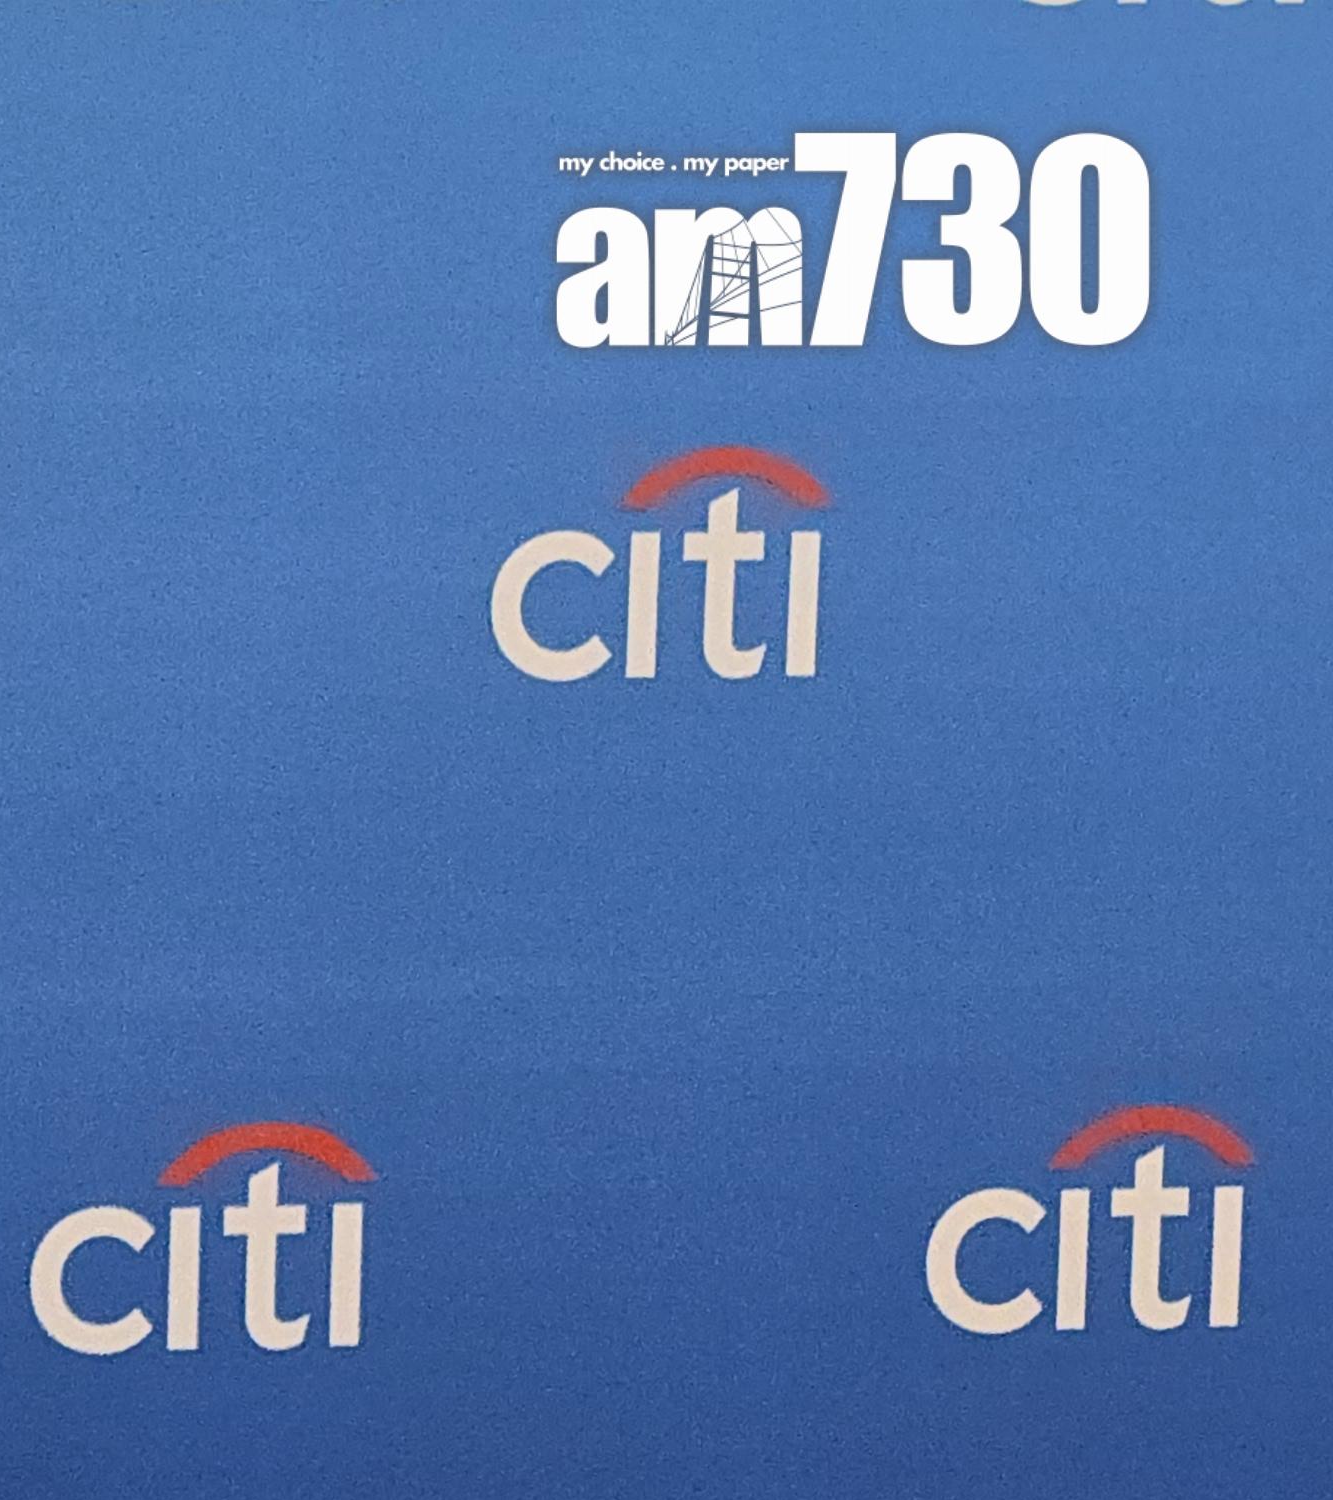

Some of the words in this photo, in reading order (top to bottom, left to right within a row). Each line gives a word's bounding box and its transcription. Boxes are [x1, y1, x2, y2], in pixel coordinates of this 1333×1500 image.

[490, 487, 822, 683] citi
[29, 1162, 364, 1357] citi
[925, 1145, 1245, 1336] citi
